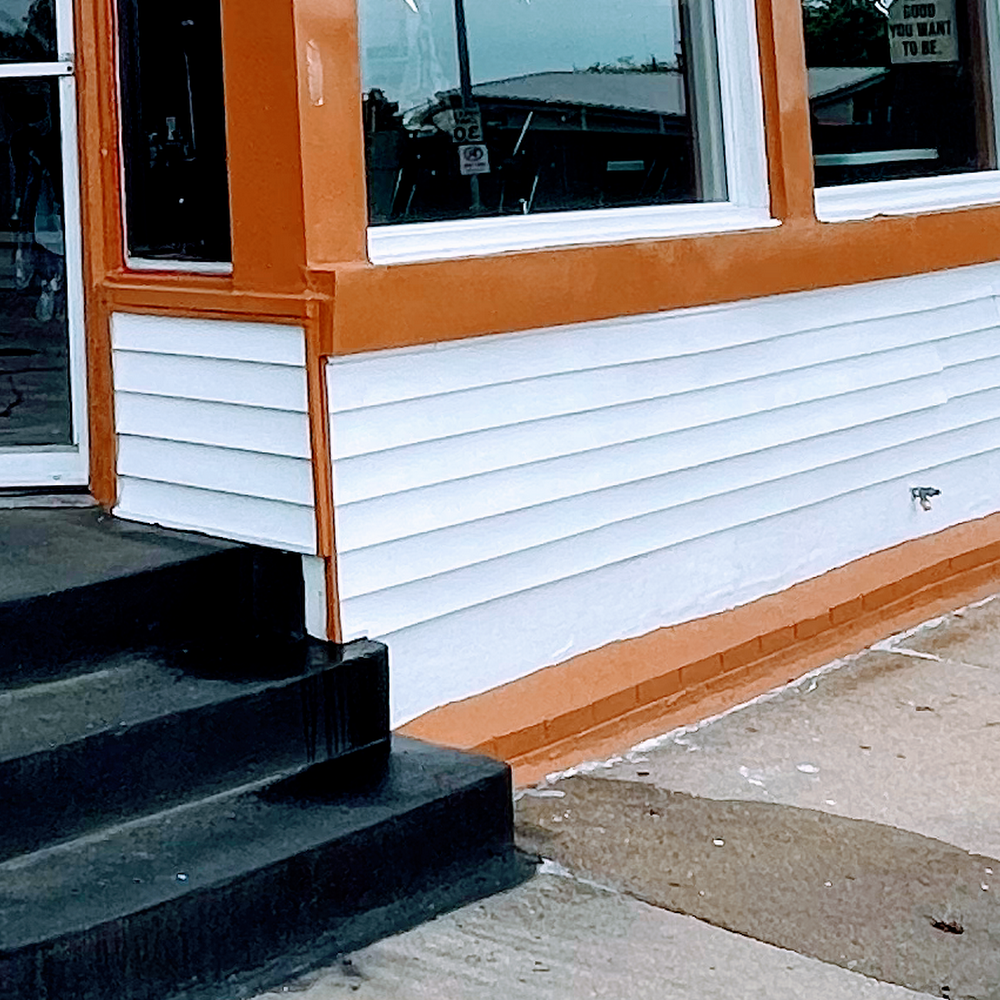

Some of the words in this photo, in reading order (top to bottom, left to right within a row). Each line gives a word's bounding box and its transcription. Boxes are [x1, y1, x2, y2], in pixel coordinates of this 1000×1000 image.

[890, 22, 913, 38] YOU
[917, 20, 951, 37] WANT
[902, 41, 918, 56] TO
